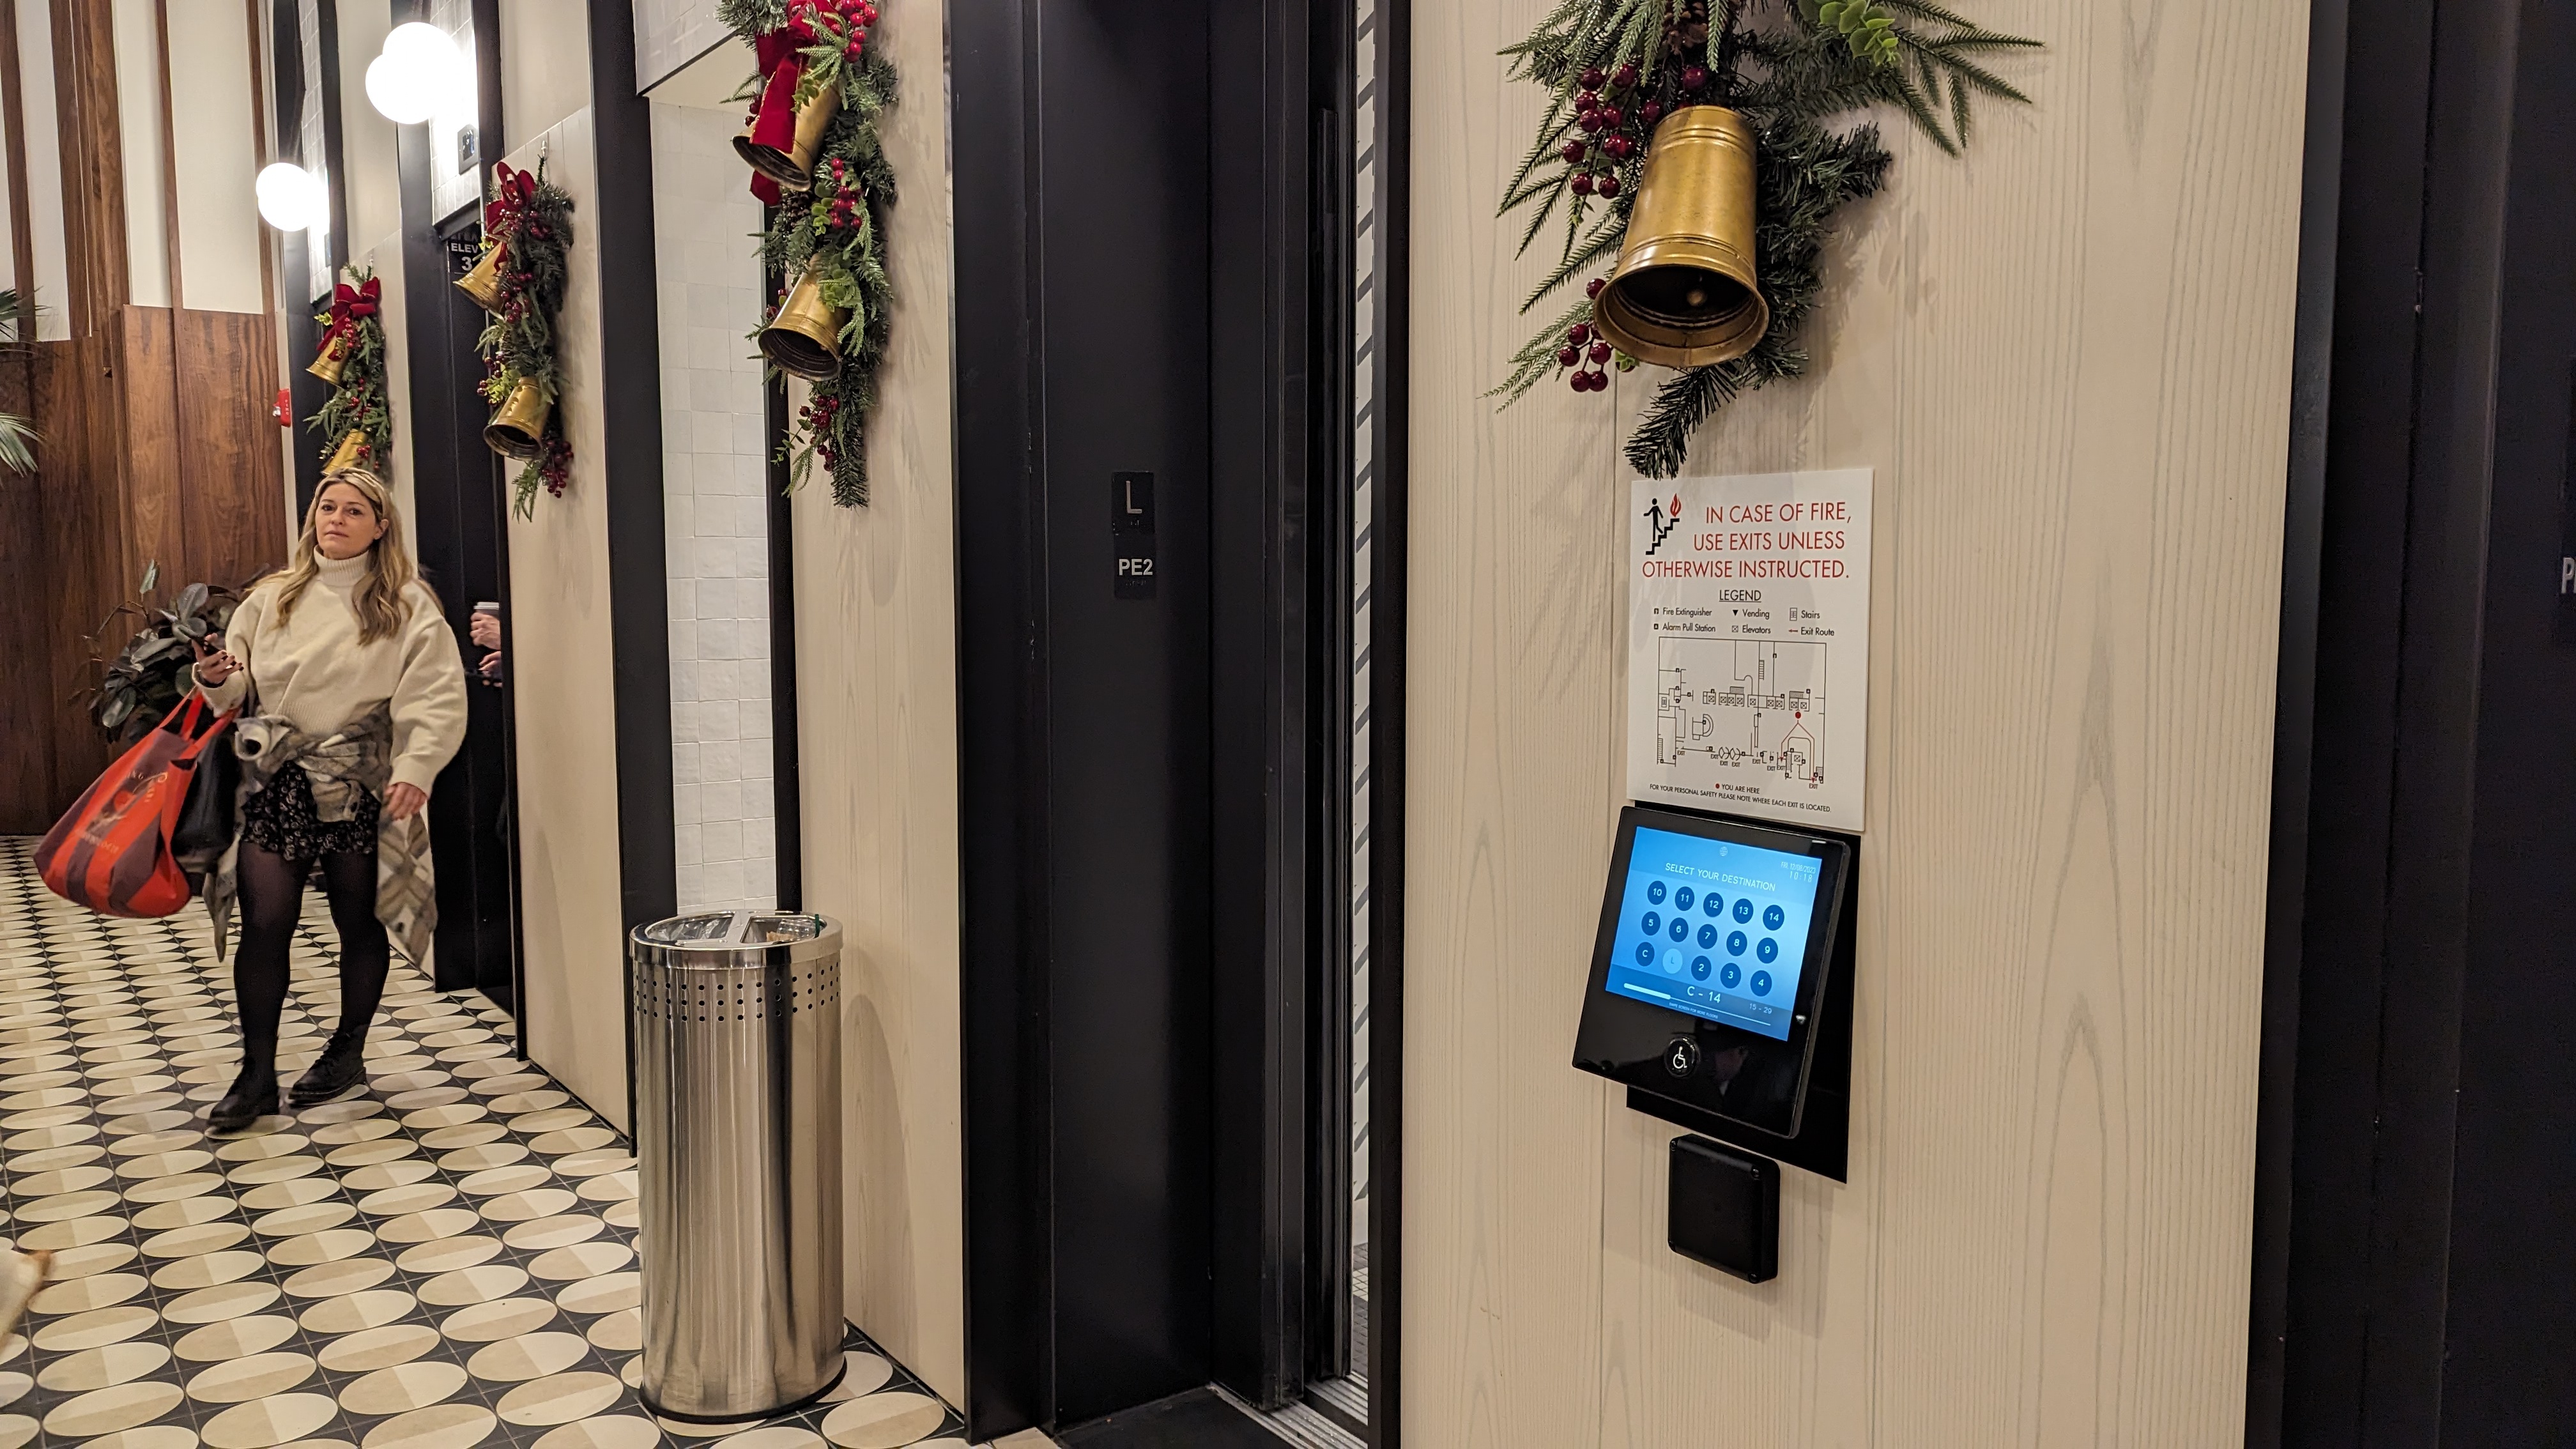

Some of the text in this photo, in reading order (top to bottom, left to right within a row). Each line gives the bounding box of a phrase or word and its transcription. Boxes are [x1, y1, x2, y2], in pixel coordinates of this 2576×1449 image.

[451, 243, 479, 254] ELEV
[1126, 480, 1142, 514] L
[1706, 502, 1851, 524] IN CASE OF FIRE,
[1694, 530, 1844, 551] USE EXITS UNLESS
[1119, 558, 1153, 576] PE2
[1642, 560, 1850, 579] OTHERWISE INSTRUCTED.
[1719, 589, 1761, 601] LEGEND
[1662, 608, 1712, 618] Fire Extinguisher
[1742, 609, 1770, 620] Vending
[1801, 610, 1820, 619] Stairs
[1662, 623, 1715, 633] Alarm Pull Station
[1742, 625, 1771, 634] Elevators
[1801, 627, 1834, 636] Exit Route
[1675, 786, 1699, 795] PERSONAL
[1700, 790, 1717, 798] SAFETY
[1806, 804, 1832, 813] LOCATED.
[1665, 863, 1776, 891] SELECT YOUR DESTINATION
[1790, 871, 1813, 882] 10:18
[1653, 887, 1662, 896] 10
[1680, 894, 1689, 902] 11
[1709, 900, 1718, 909] 12
[1738, 906, 1749, 915] 13
[1769, 912, 1779, 921] 14
[1765, 946, 1770, 954] 9
[1699, 963, 1704, 972] 2
[1687, 986, 1695, 996] C
[1708, 992, 1721, 1004] 14
